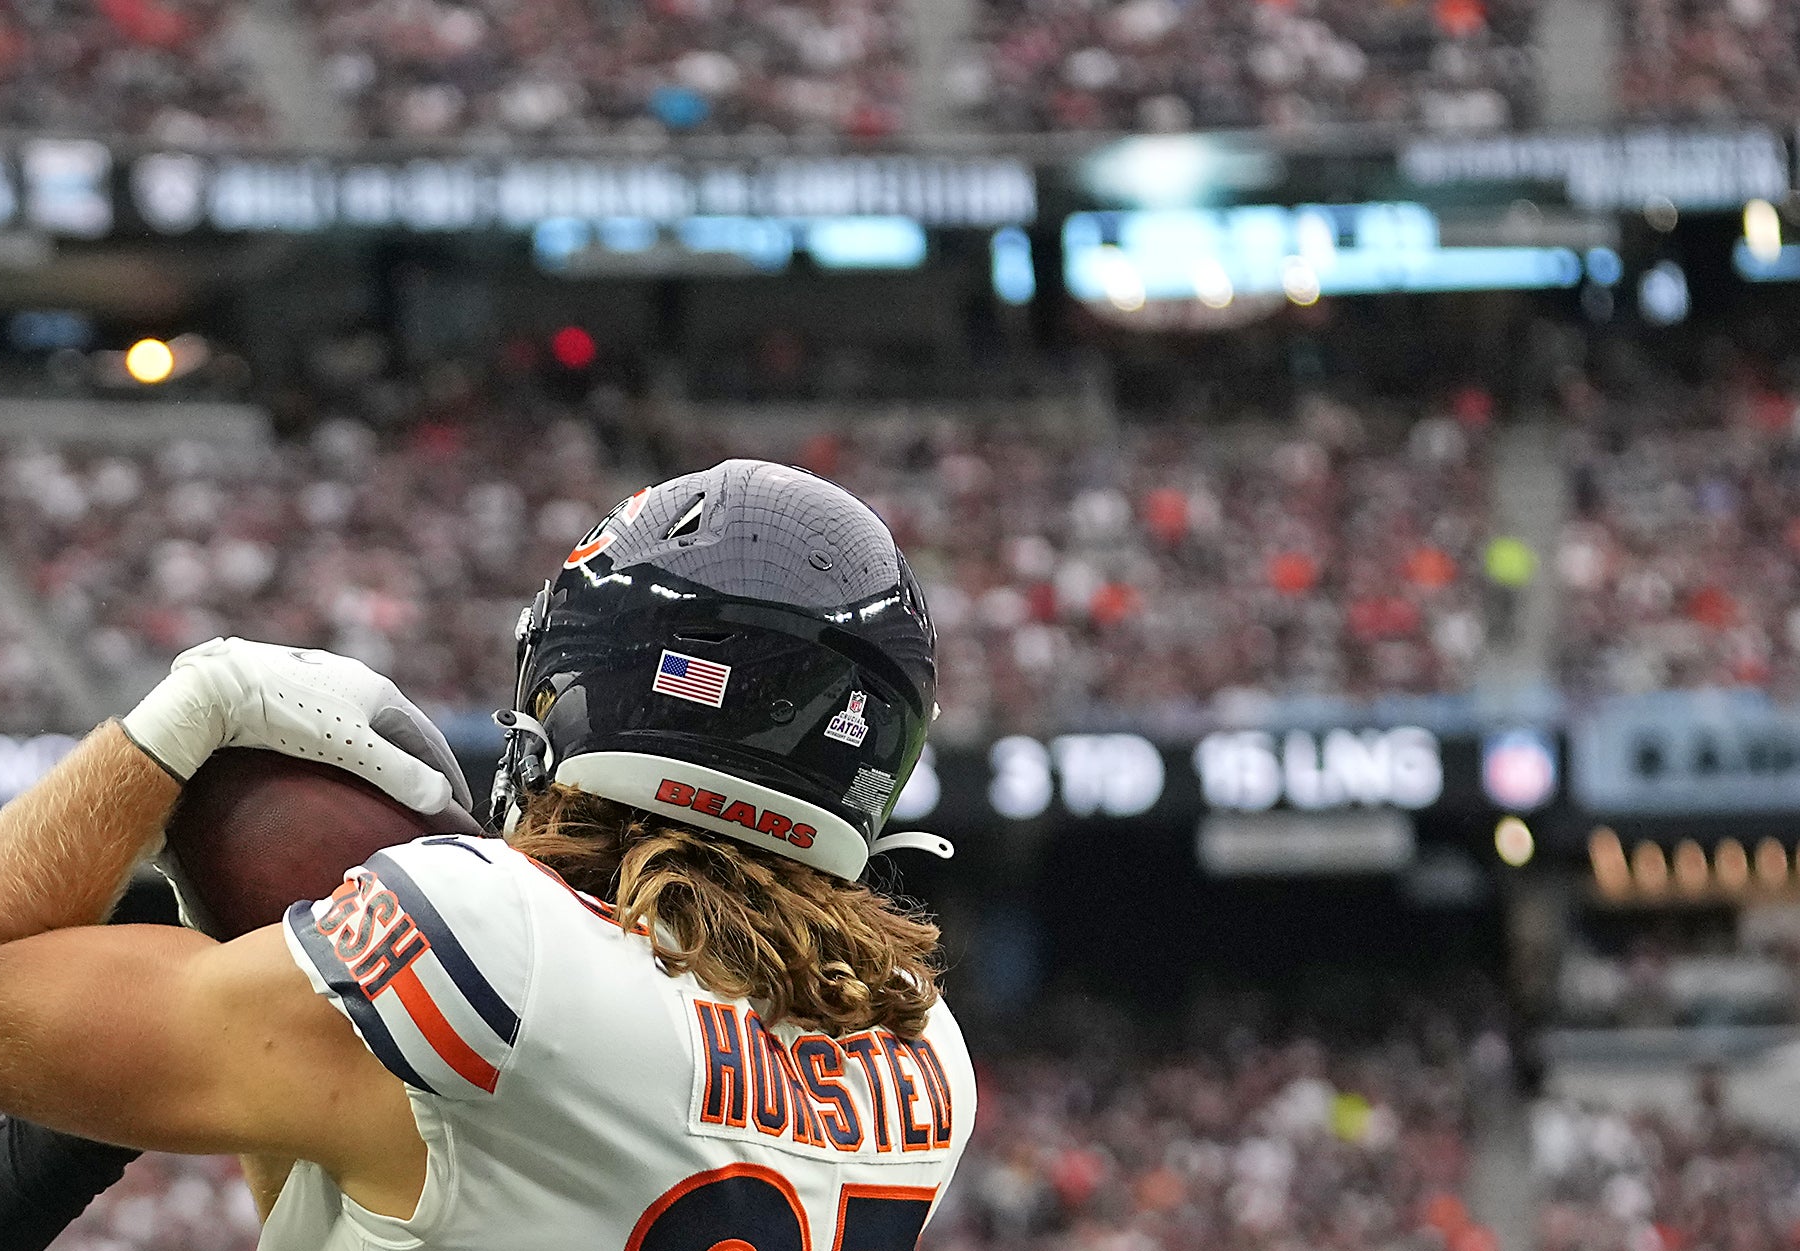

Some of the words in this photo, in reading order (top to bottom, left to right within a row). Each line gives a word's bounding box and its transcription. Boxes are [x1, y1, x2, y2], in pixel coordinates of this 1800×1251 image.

[830, 718, 866, 739] CATCH
[840, 712, 864, 725] CRUCIAL
[992, 736, 1049, 816] 3
[1052, 734, 1161, 813] TD
[1284, 727, 1441, 806] LNG
[654, 778, 817, 849] BEARS
